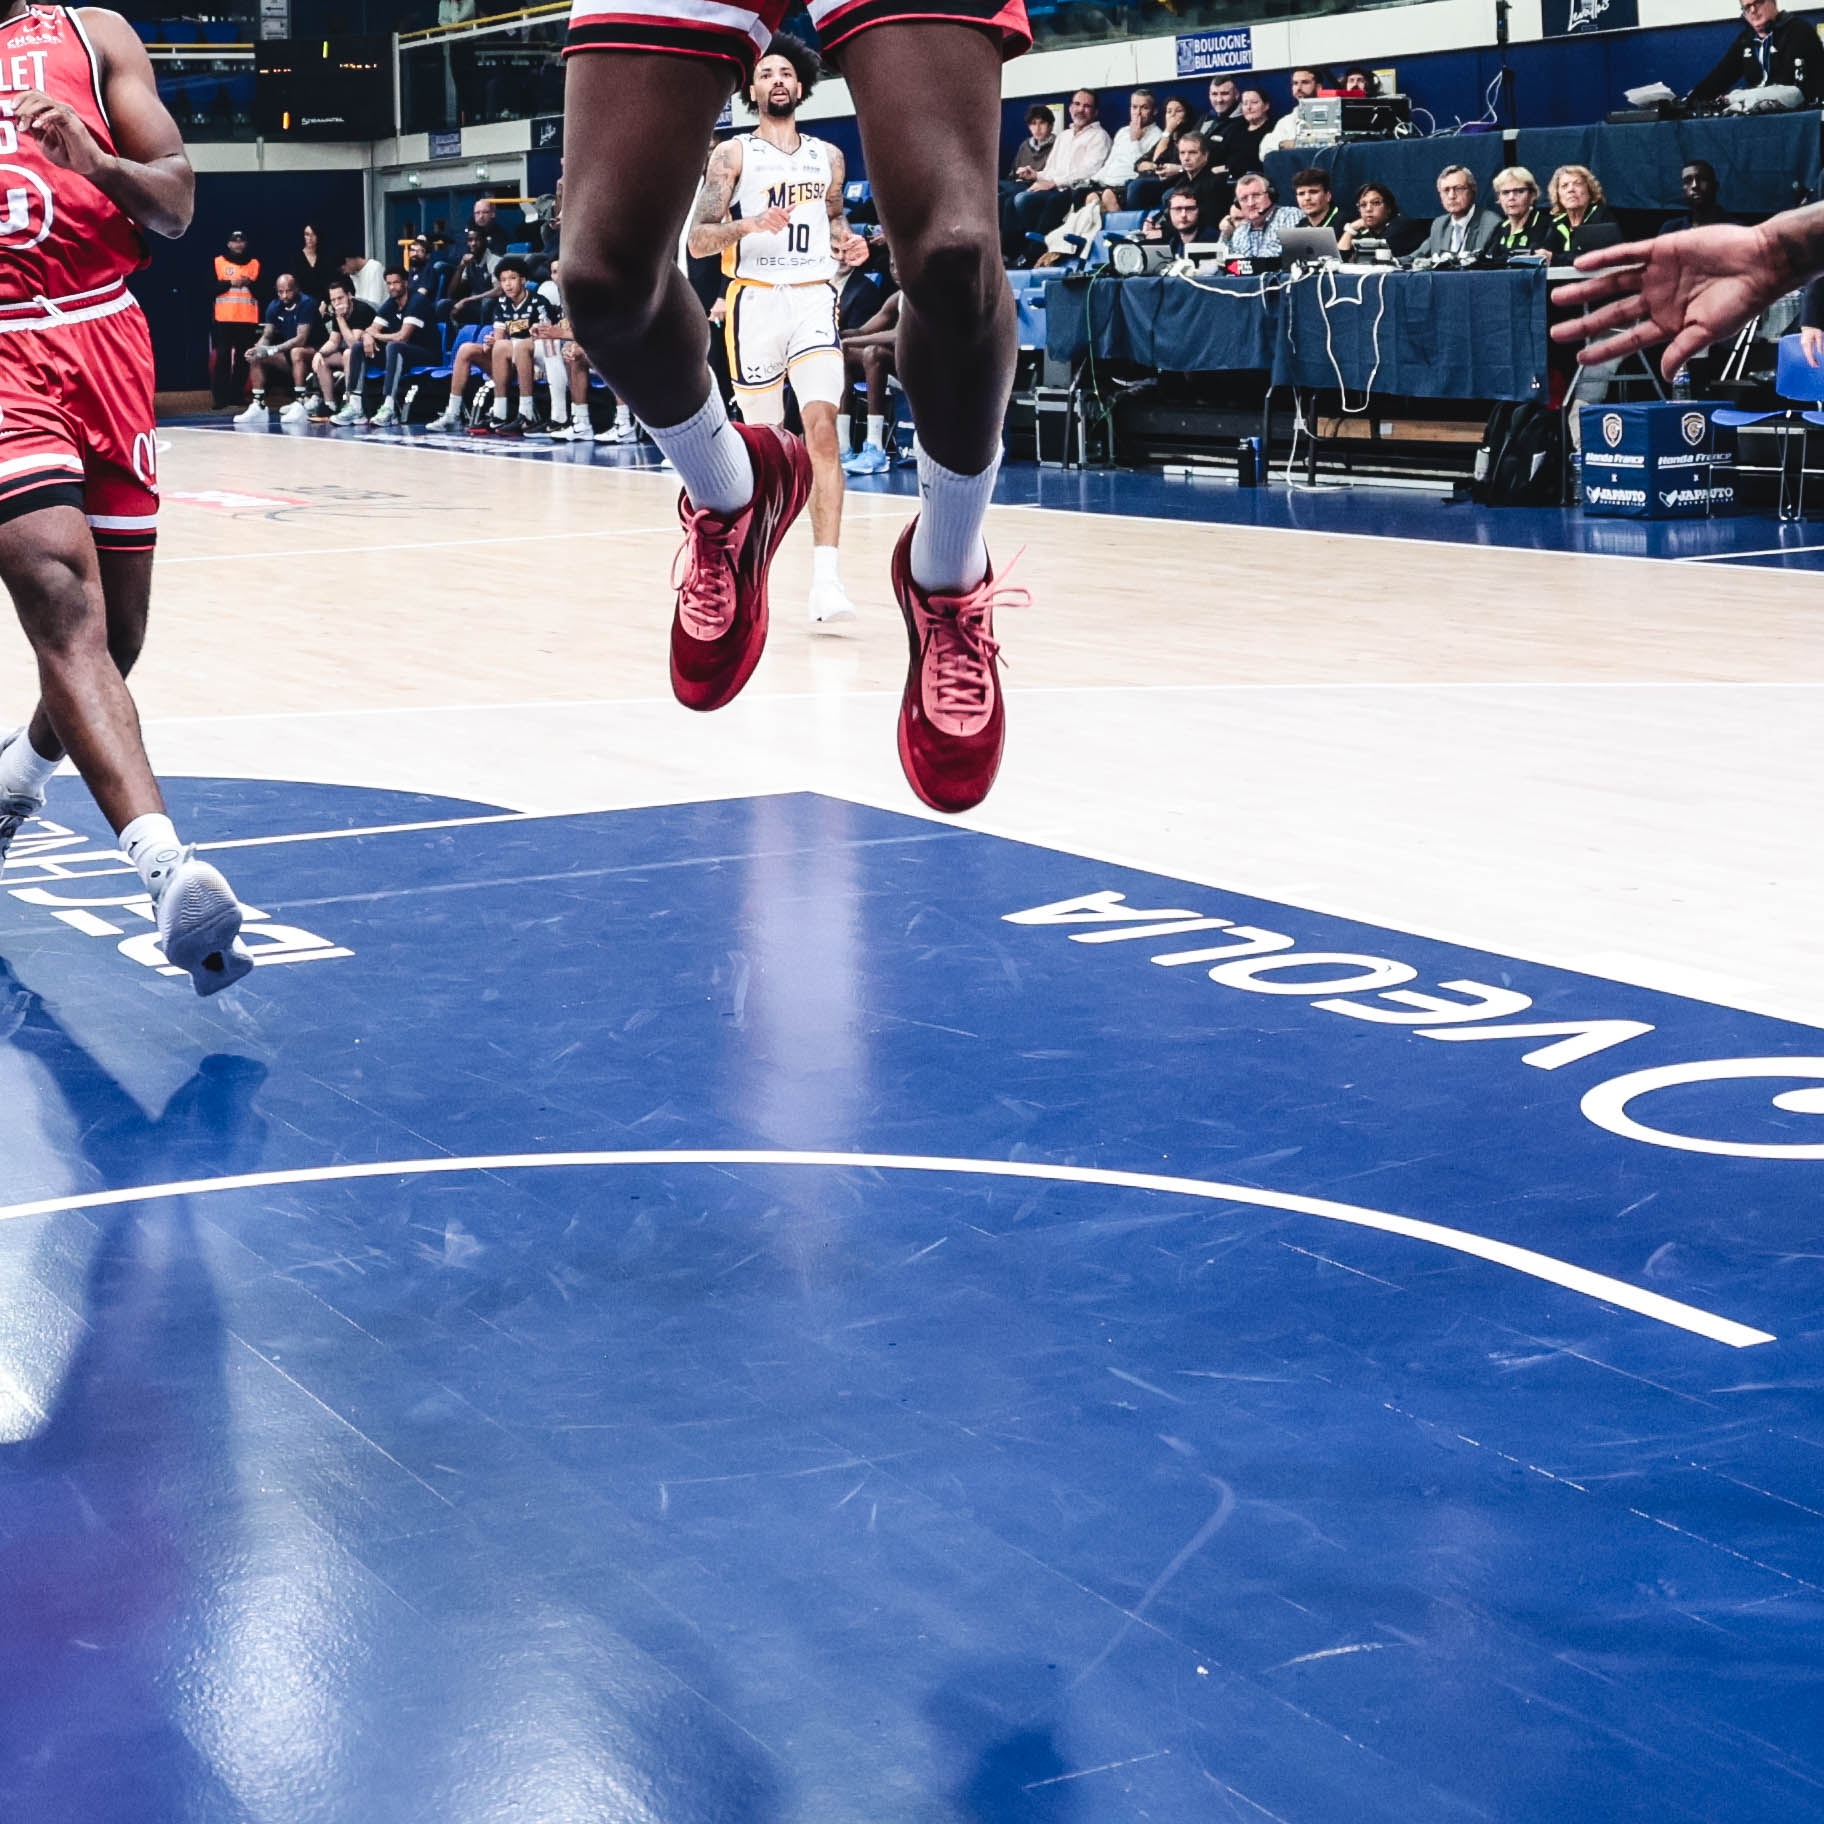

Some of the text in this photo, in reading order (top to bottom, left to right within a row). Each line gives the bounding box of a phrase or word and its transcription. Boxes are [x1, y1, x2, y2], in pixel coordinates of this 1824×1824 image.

[1194, 34, 1252, 53] BOULOGNE-
[1195, 49, 1253, 69] BILLANCOURT
[787, 223, 810, 254] 10
[1585, 453, 1645, 464] Honda France
[1658, 455, 1694, 466] Honda
[1599, 488, 1647, 502] JAPAUTO
[1001, 889, 1656, 1070] VEOLIA
